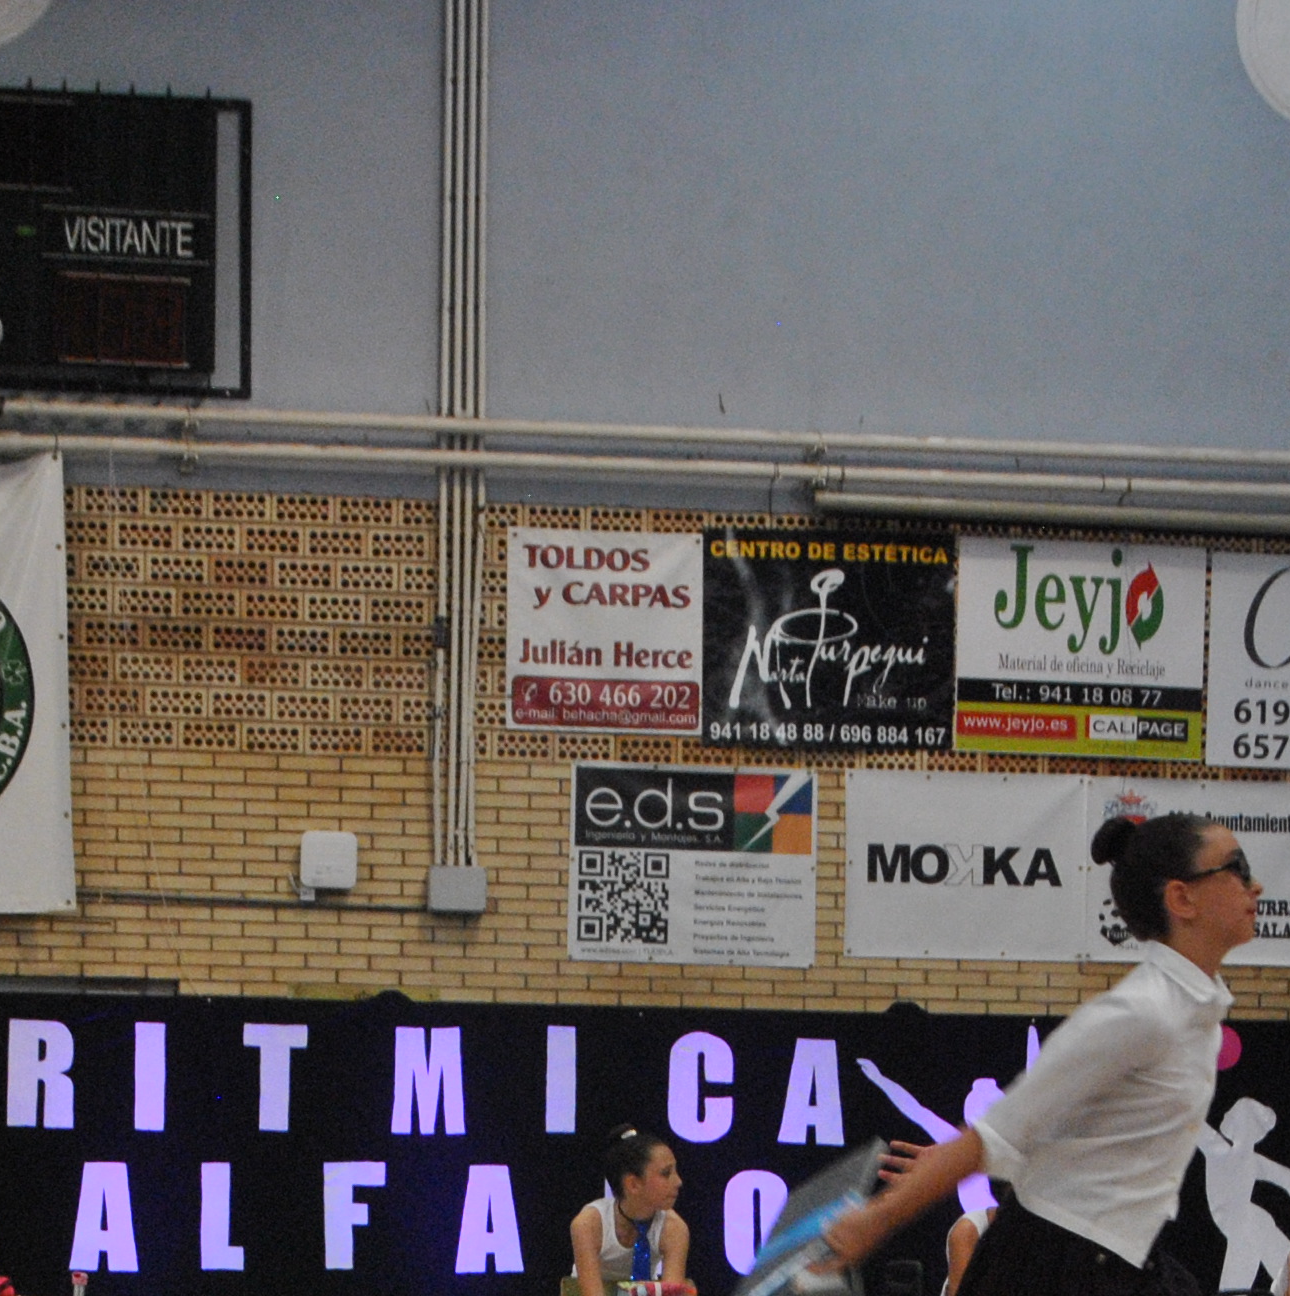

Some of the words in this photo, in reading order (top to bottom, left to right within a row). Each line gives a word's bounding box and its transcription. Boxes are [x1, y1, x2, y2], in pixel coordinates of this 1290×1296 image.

[64, 215, 195, 260] VISITANTE
[523, 544, 651, 572] TOLDOS
[710, 540, 801, 559] CENTRO
[808, 541, 836, 560] DE
[533, 585, 552, 610] y
[561, 581, 692, 609] CARPAS
[993, 543, 1165, 655] Jeyjo
[519, 638, 603, 667] Julián
[613, 641, 694, 669] Herce
[998, 653, 1047, 672] Material
[1050, 656, 1063, 672] de
[1066, 656, 1104, 674] oficina
[1116, 659, 1166, 681] Reciclaje
[549, 681, 592, 706] 630
[599, 684, 641, 708] 466
[650, 685, 692, 709] 202
[1039, 684, 1073, 703] 941
[1082, 687, 1104, 704] 18
[1110, 688, 1133, 705] 08
[1140, 689, 1163, 706] 77
[1244, 677, 1290, 690] dance
[963, 713, 1069, 733] www.jeyjo.es
[1234, 699, 1290, 726] 619
[710, 721, 742, 741] 941
[749, 723, 771, 741] 18
[775, 723, 798, 742] 48
[803, 724, 825, 742] 88
[840, 724, 872, 743] 696
[877, 726, 909, 743] 884
[914, 726, 946, 745] 167
[1233, 733, 1290, 761] 657
[585, 778, 726, 832] e.d.s
[6, 1017, 846, 1147] RITMICA
[70, 1160, 790, 1277] ALFAO
